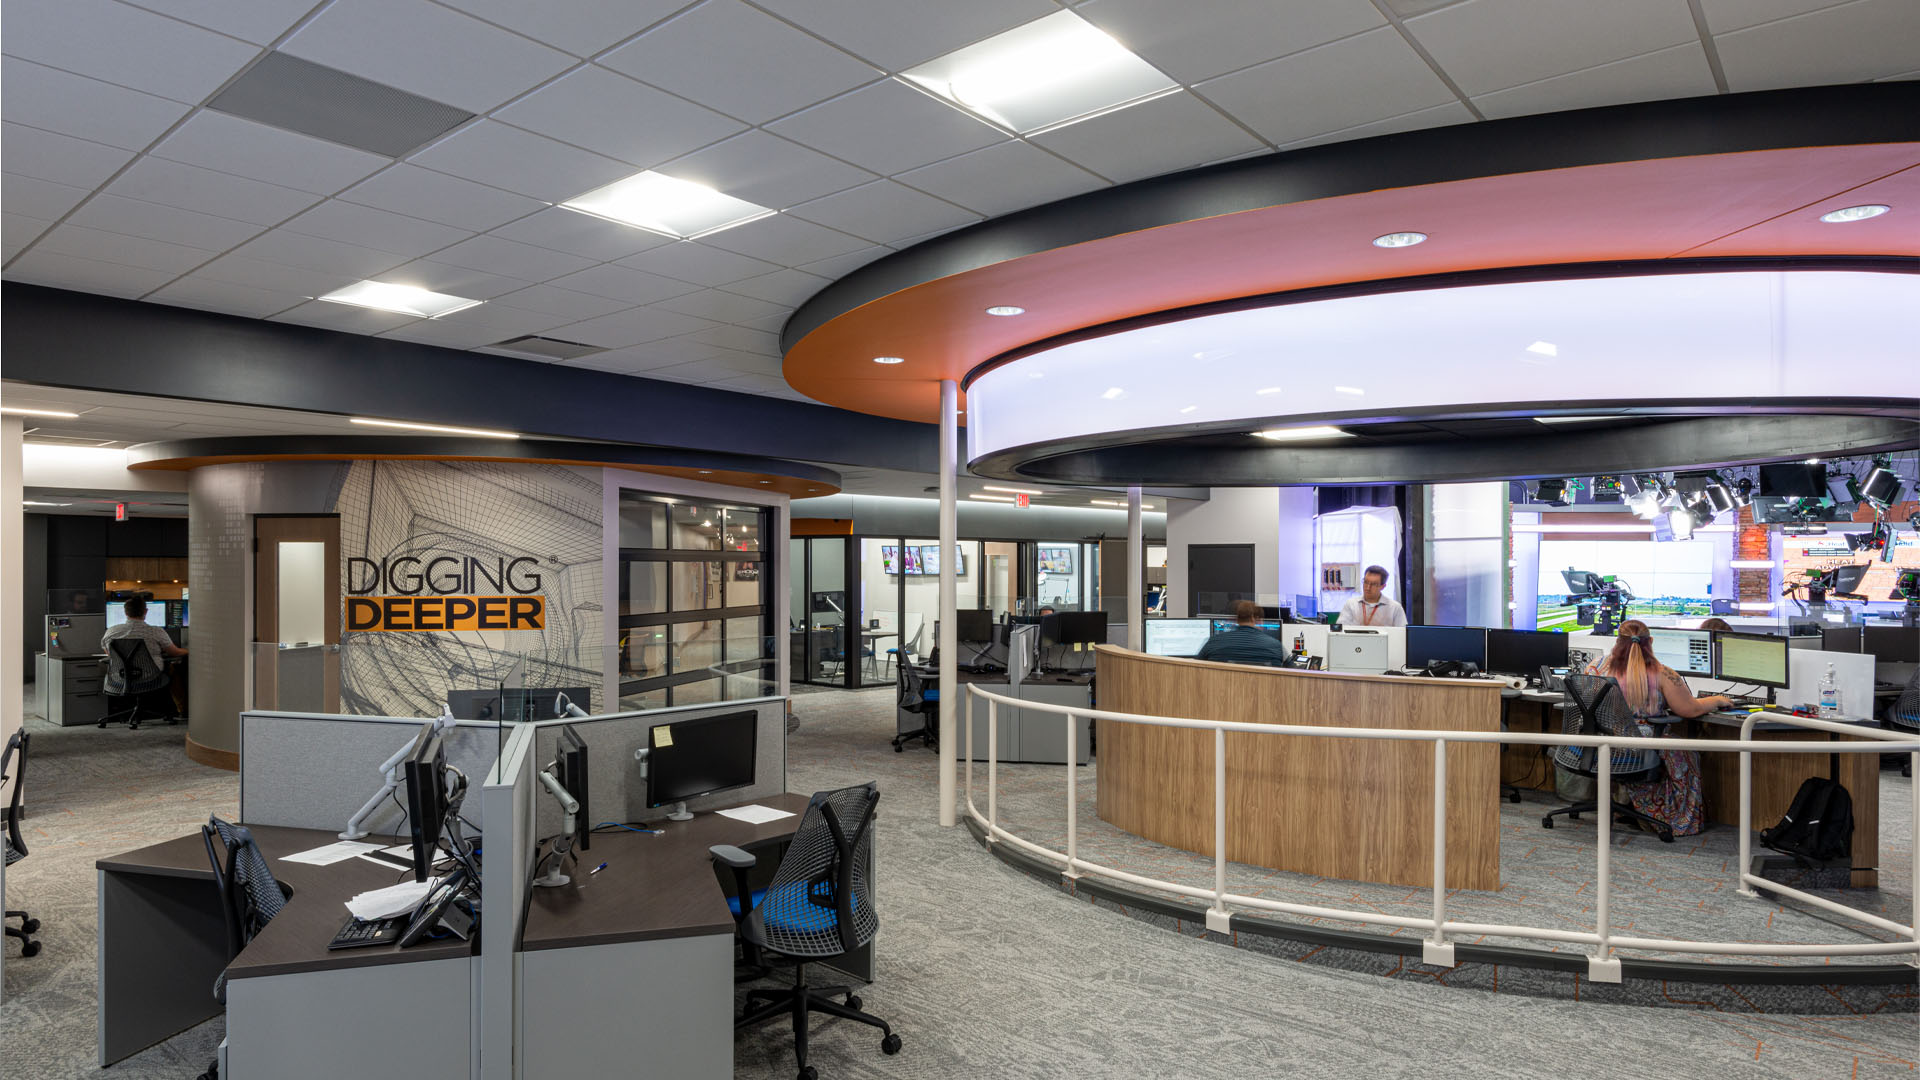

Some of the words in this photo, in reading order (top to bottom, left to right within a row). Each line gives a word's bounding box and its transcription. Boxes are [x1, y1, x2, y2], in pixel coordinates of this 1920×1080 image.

[1018, 493, 1028, 506] EXIT
[347, 556, 541, 594] DIGGING
[349, 598, 542, 630] DEEPER
